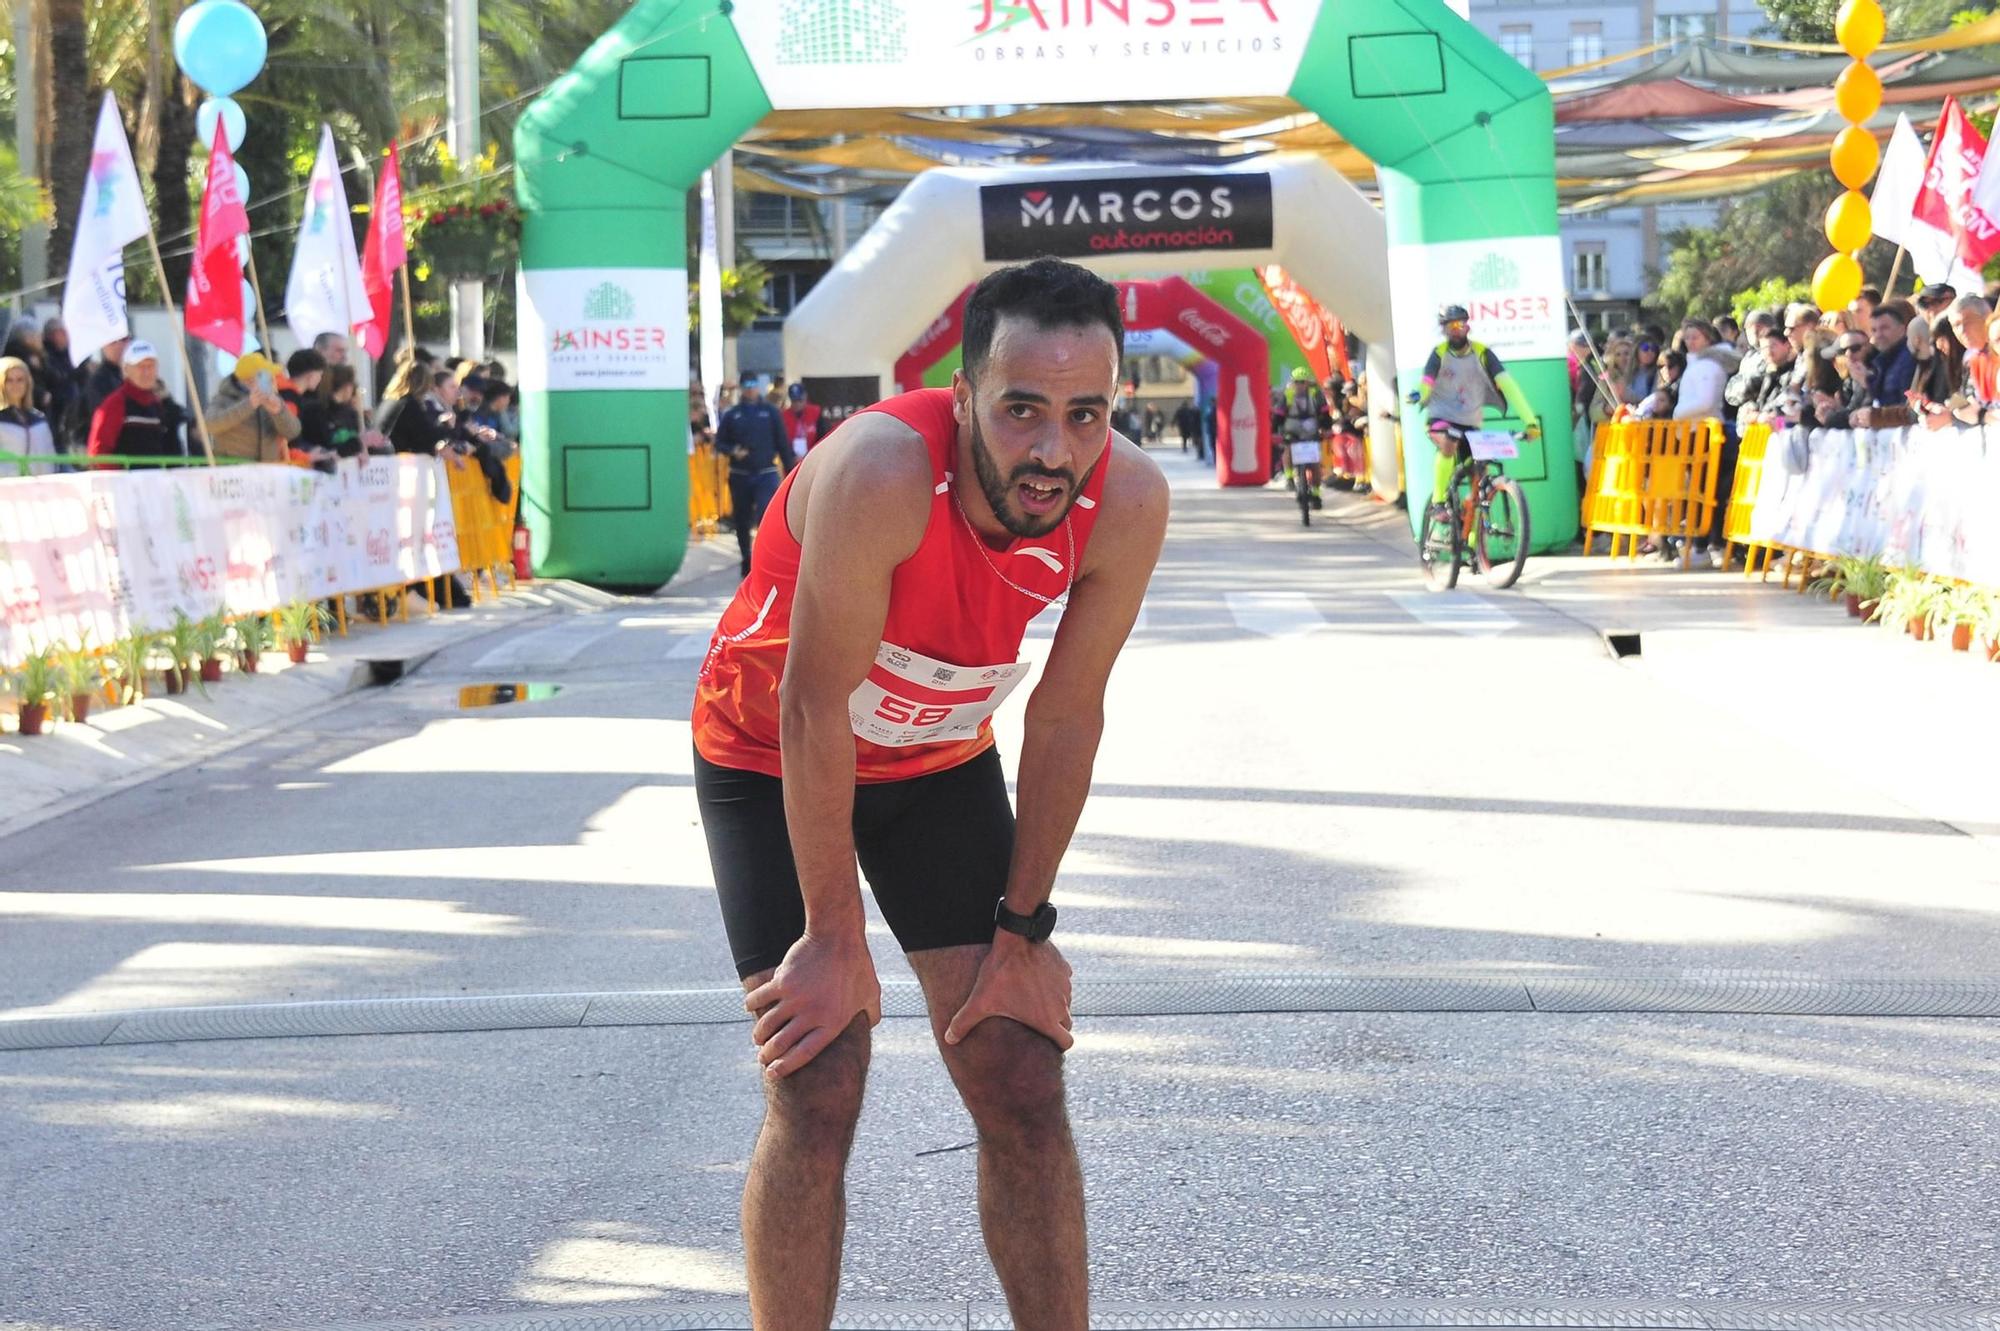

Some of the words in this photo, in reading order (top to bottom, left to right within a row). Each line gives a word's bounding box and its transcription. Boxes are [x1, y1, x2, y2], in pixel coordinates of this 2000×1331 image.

[975, 45, 1065, 61] OBRAS
[1089, 44, 1099, 58] Y
[1123, 36, 1281, 57] SERVICIOS
[1020, 188, 1233, 227] MARCOS
[1090, 226, 1234, 250] automoción
[1468, 297, 1549, 321] INSER
[553, 328, 665, 352] JAINSER
[875, 696, 953, 726] 58
